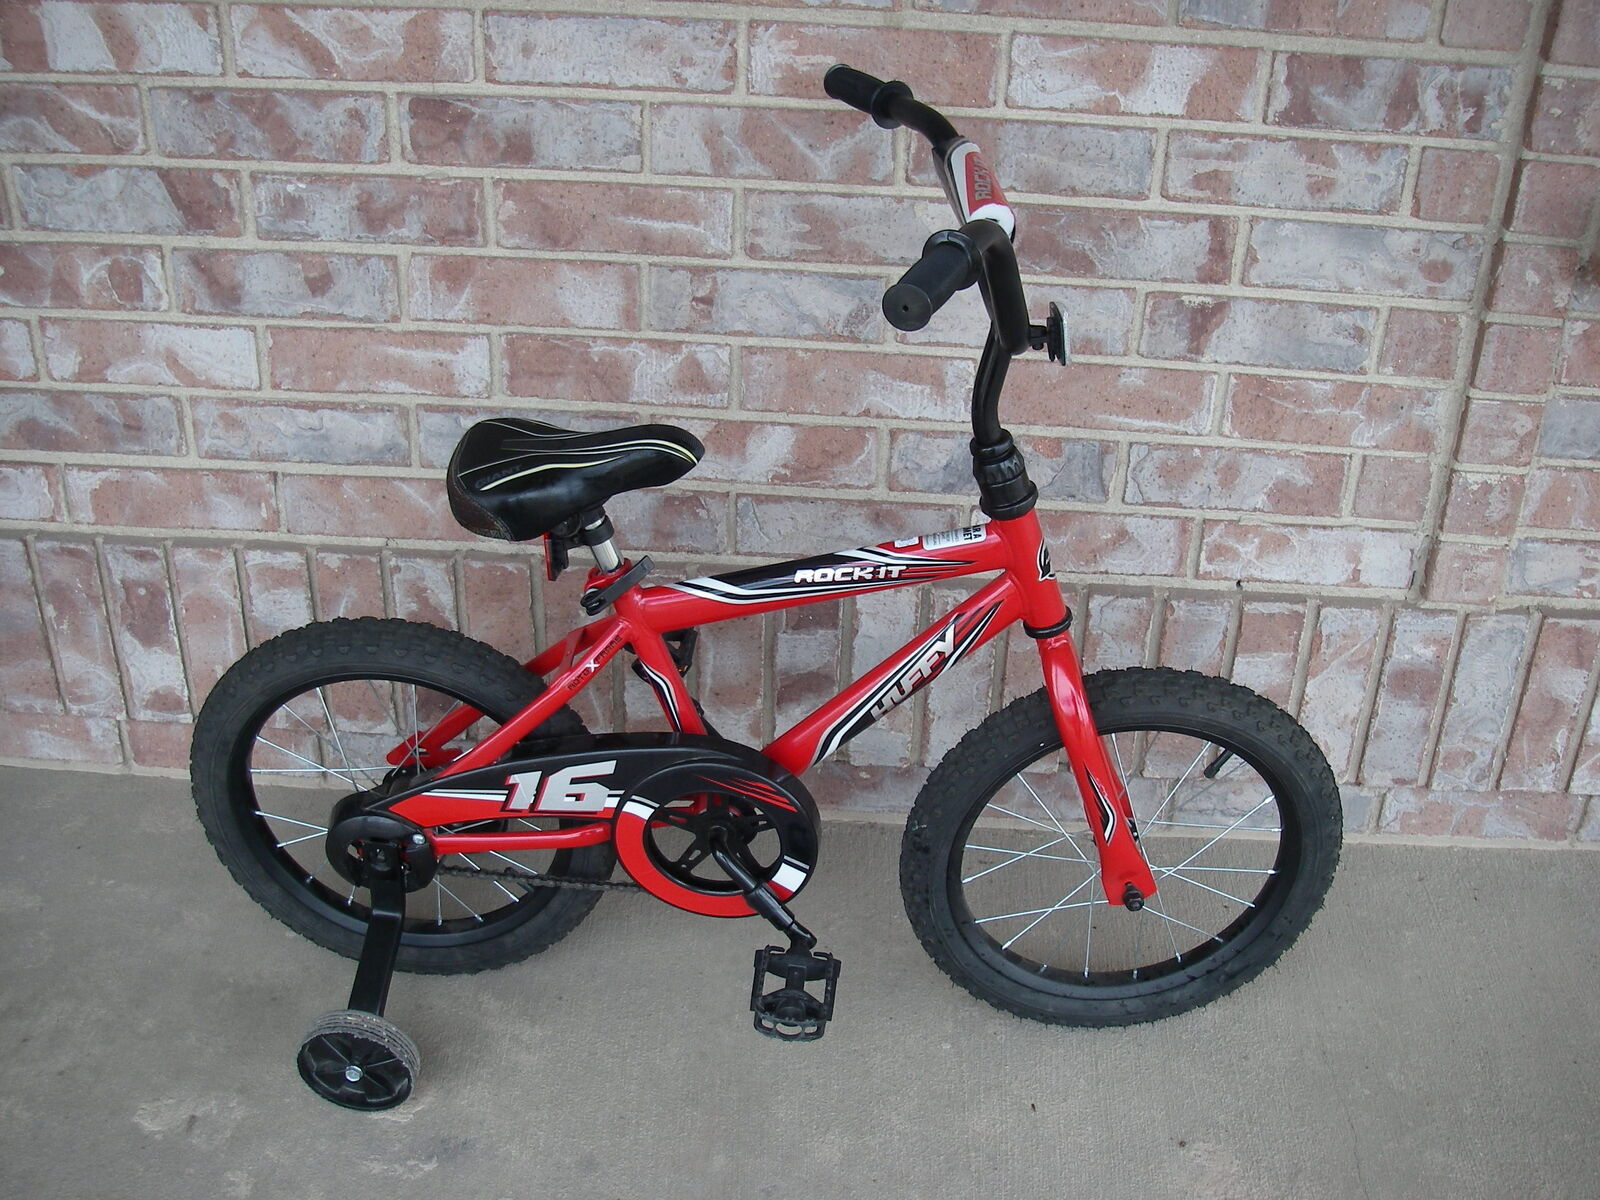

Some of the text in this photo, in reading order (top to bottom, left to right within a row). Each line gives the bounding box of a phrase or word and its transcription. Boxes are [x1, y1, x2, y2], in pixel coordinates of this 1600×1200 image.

[474, 465, 523, 488] GIANT
[870, 622, 956, 721] HUFFY
[502, 760, 617, 814] 16
